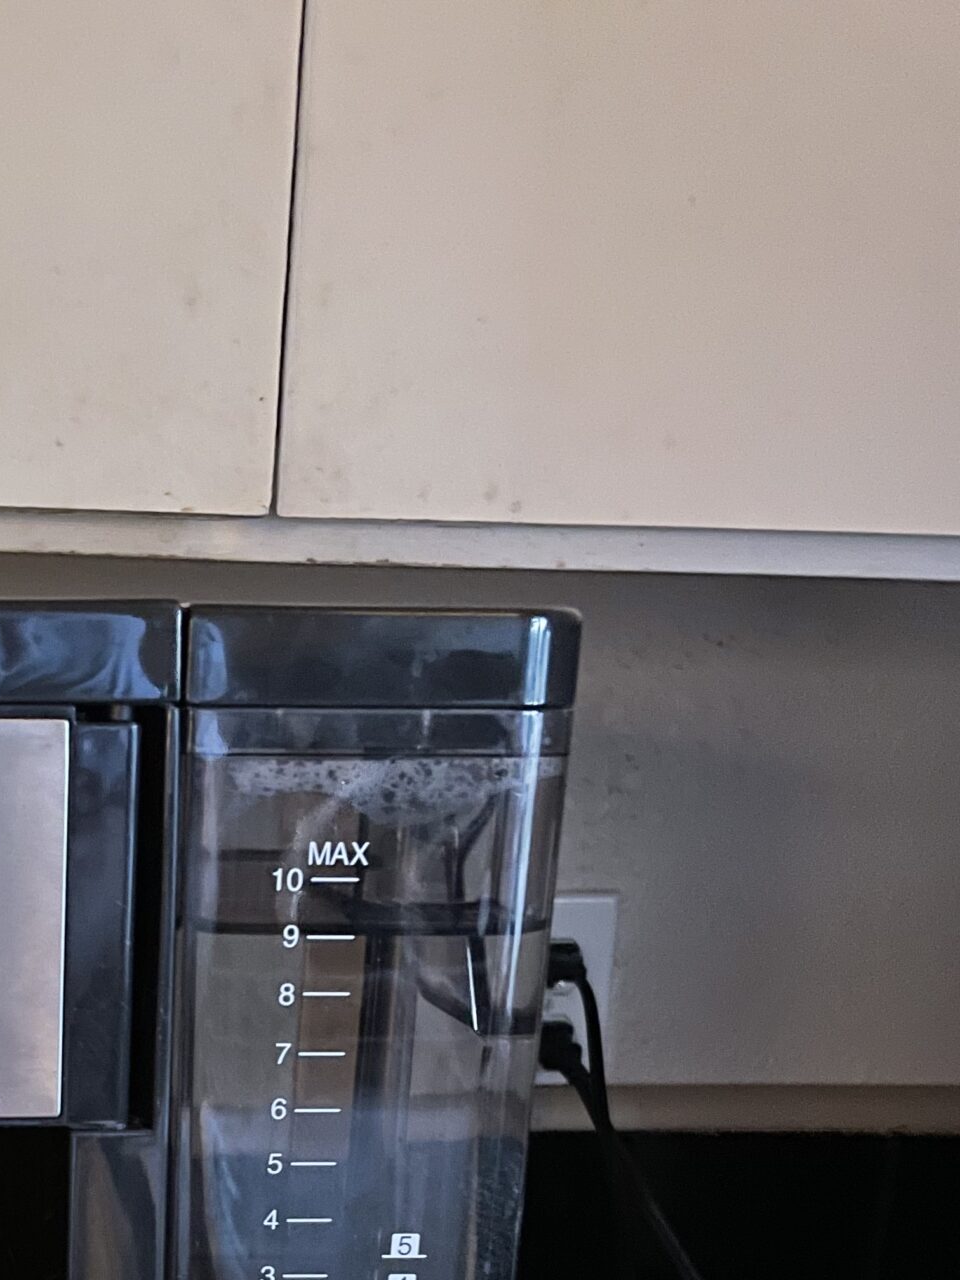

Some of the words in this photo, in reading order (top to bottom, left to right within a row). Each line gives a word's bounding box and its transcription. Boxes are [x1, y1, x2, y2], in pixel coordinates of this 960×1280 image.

[308, 841, 370, 866] MAX
[272, 868, 304, 892] 10
[282, 924, 300, 948] 9
[278, 983, 296, 1006] 8
[275, 1043, 292, 1064] 7
[270, 1098, 287, 1120] 6
[266, 1153, 283, 1175] 5
[262, 1209, 279, 1230] 4
[397, 1236, 412, 1255] 5
